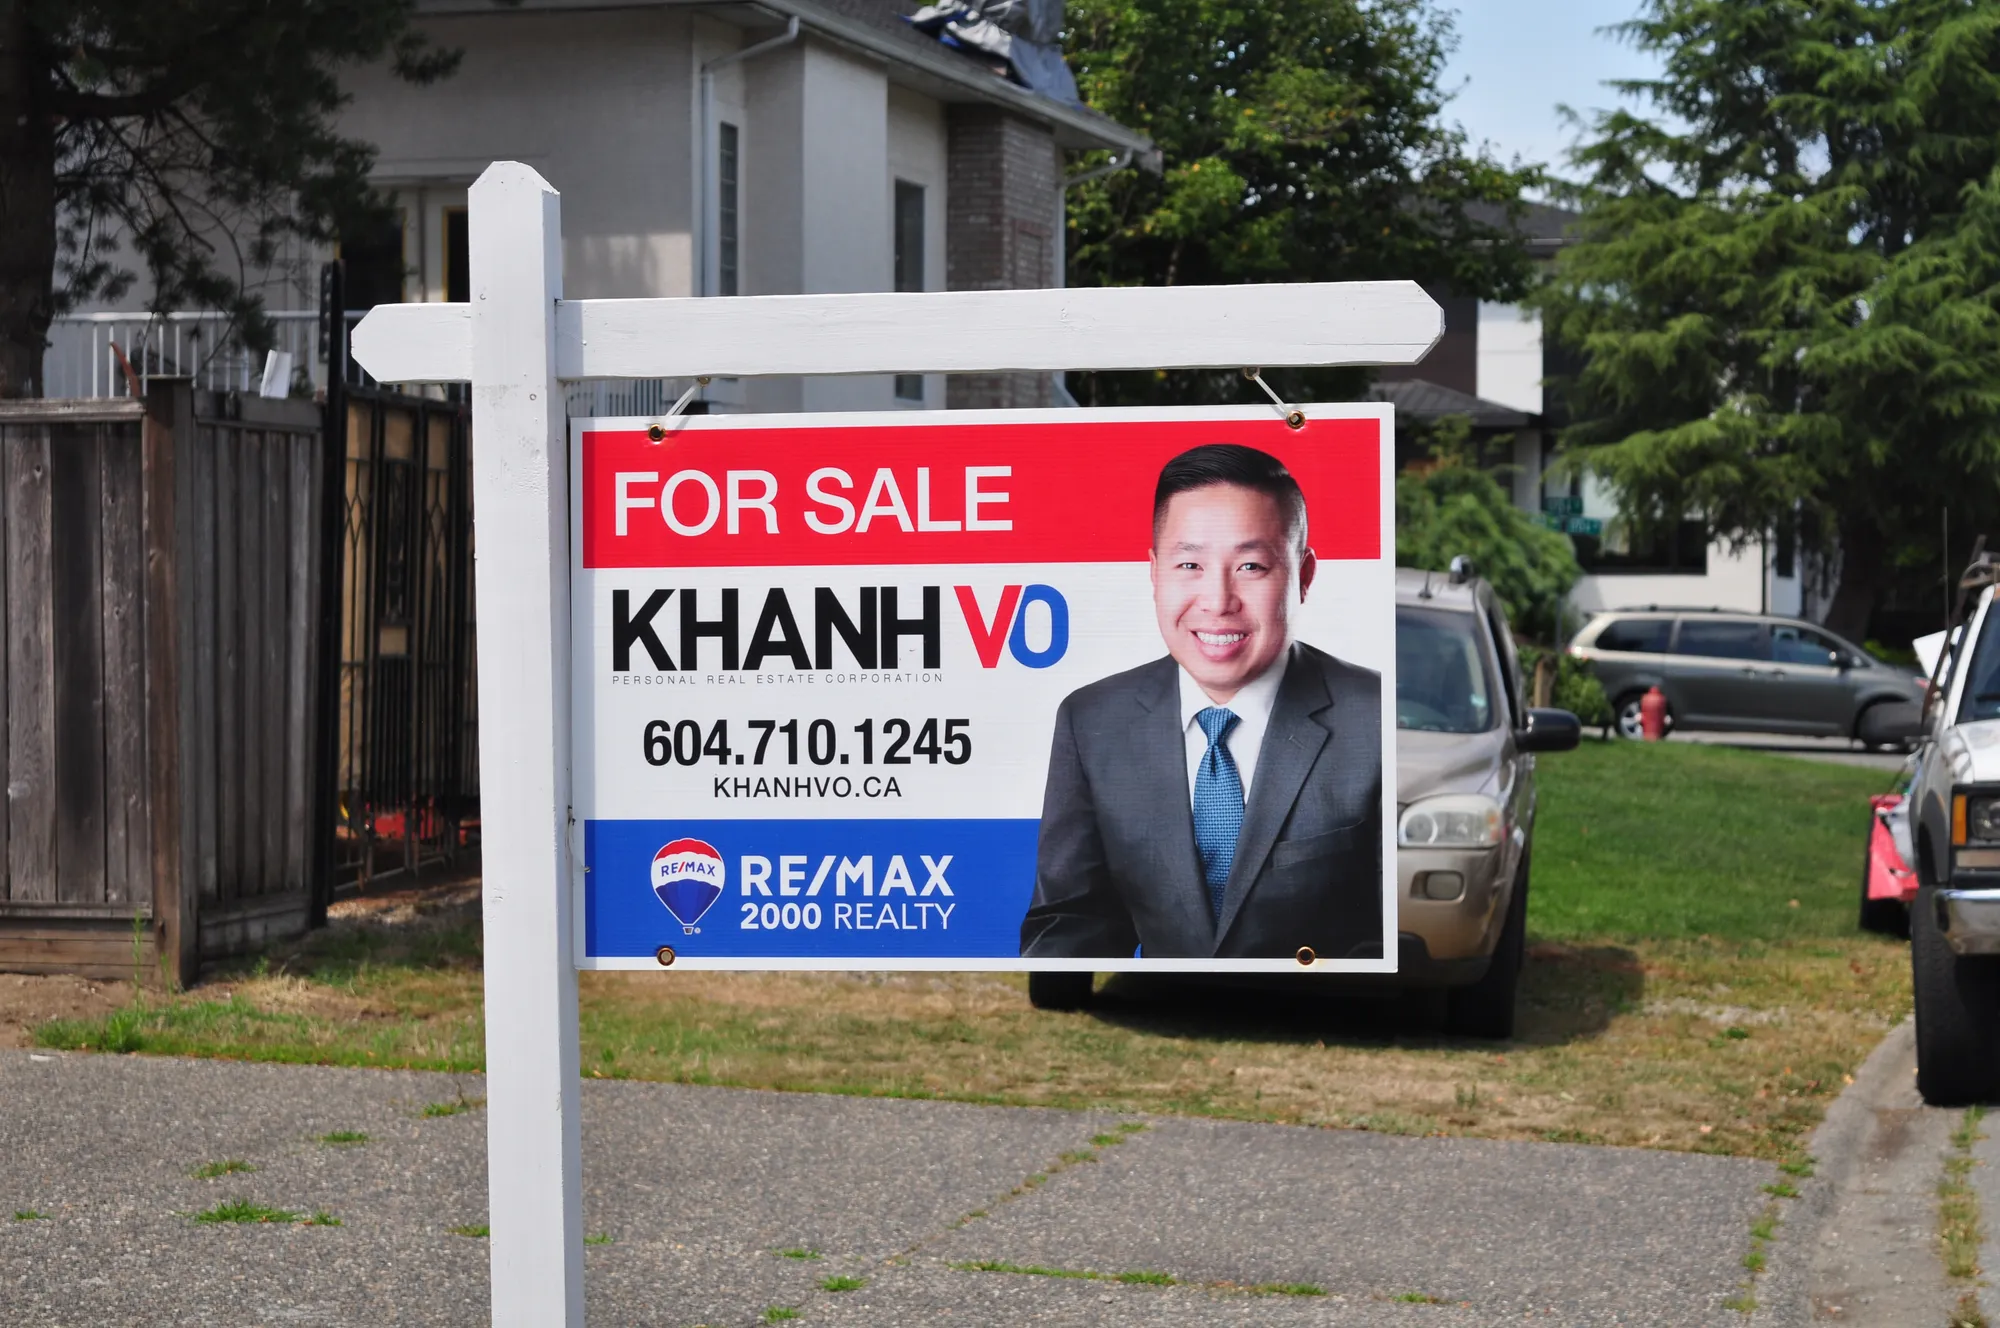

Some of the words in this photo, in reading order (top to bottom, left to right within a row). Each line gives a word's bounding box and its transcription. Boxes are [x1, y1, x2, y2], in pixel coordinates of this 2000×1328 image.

[615, 469, 780, 537] FOR
[803, 466, 1014, 535] SALE
[612, 585, 941, 671] KHANH
[953, 583, 1070, 669] VO
[612, 674, 696, 685] PERSONAL
[706, 674, 746, 685] REAL
[756, 673, 815, 684] ESTATE
[825, 672, 943, 684] CORPORATION
[643, 717, 972, 766] 604.710.1245
[713, 776, 902, 798] KHANHVO.CA
[660, 861, 716, 877] RE/MAX
[741, 855, 955, 897] RE/MAX
[740, 902, 822, 930] 2000
[834, 902, 956, 930] REALTY
